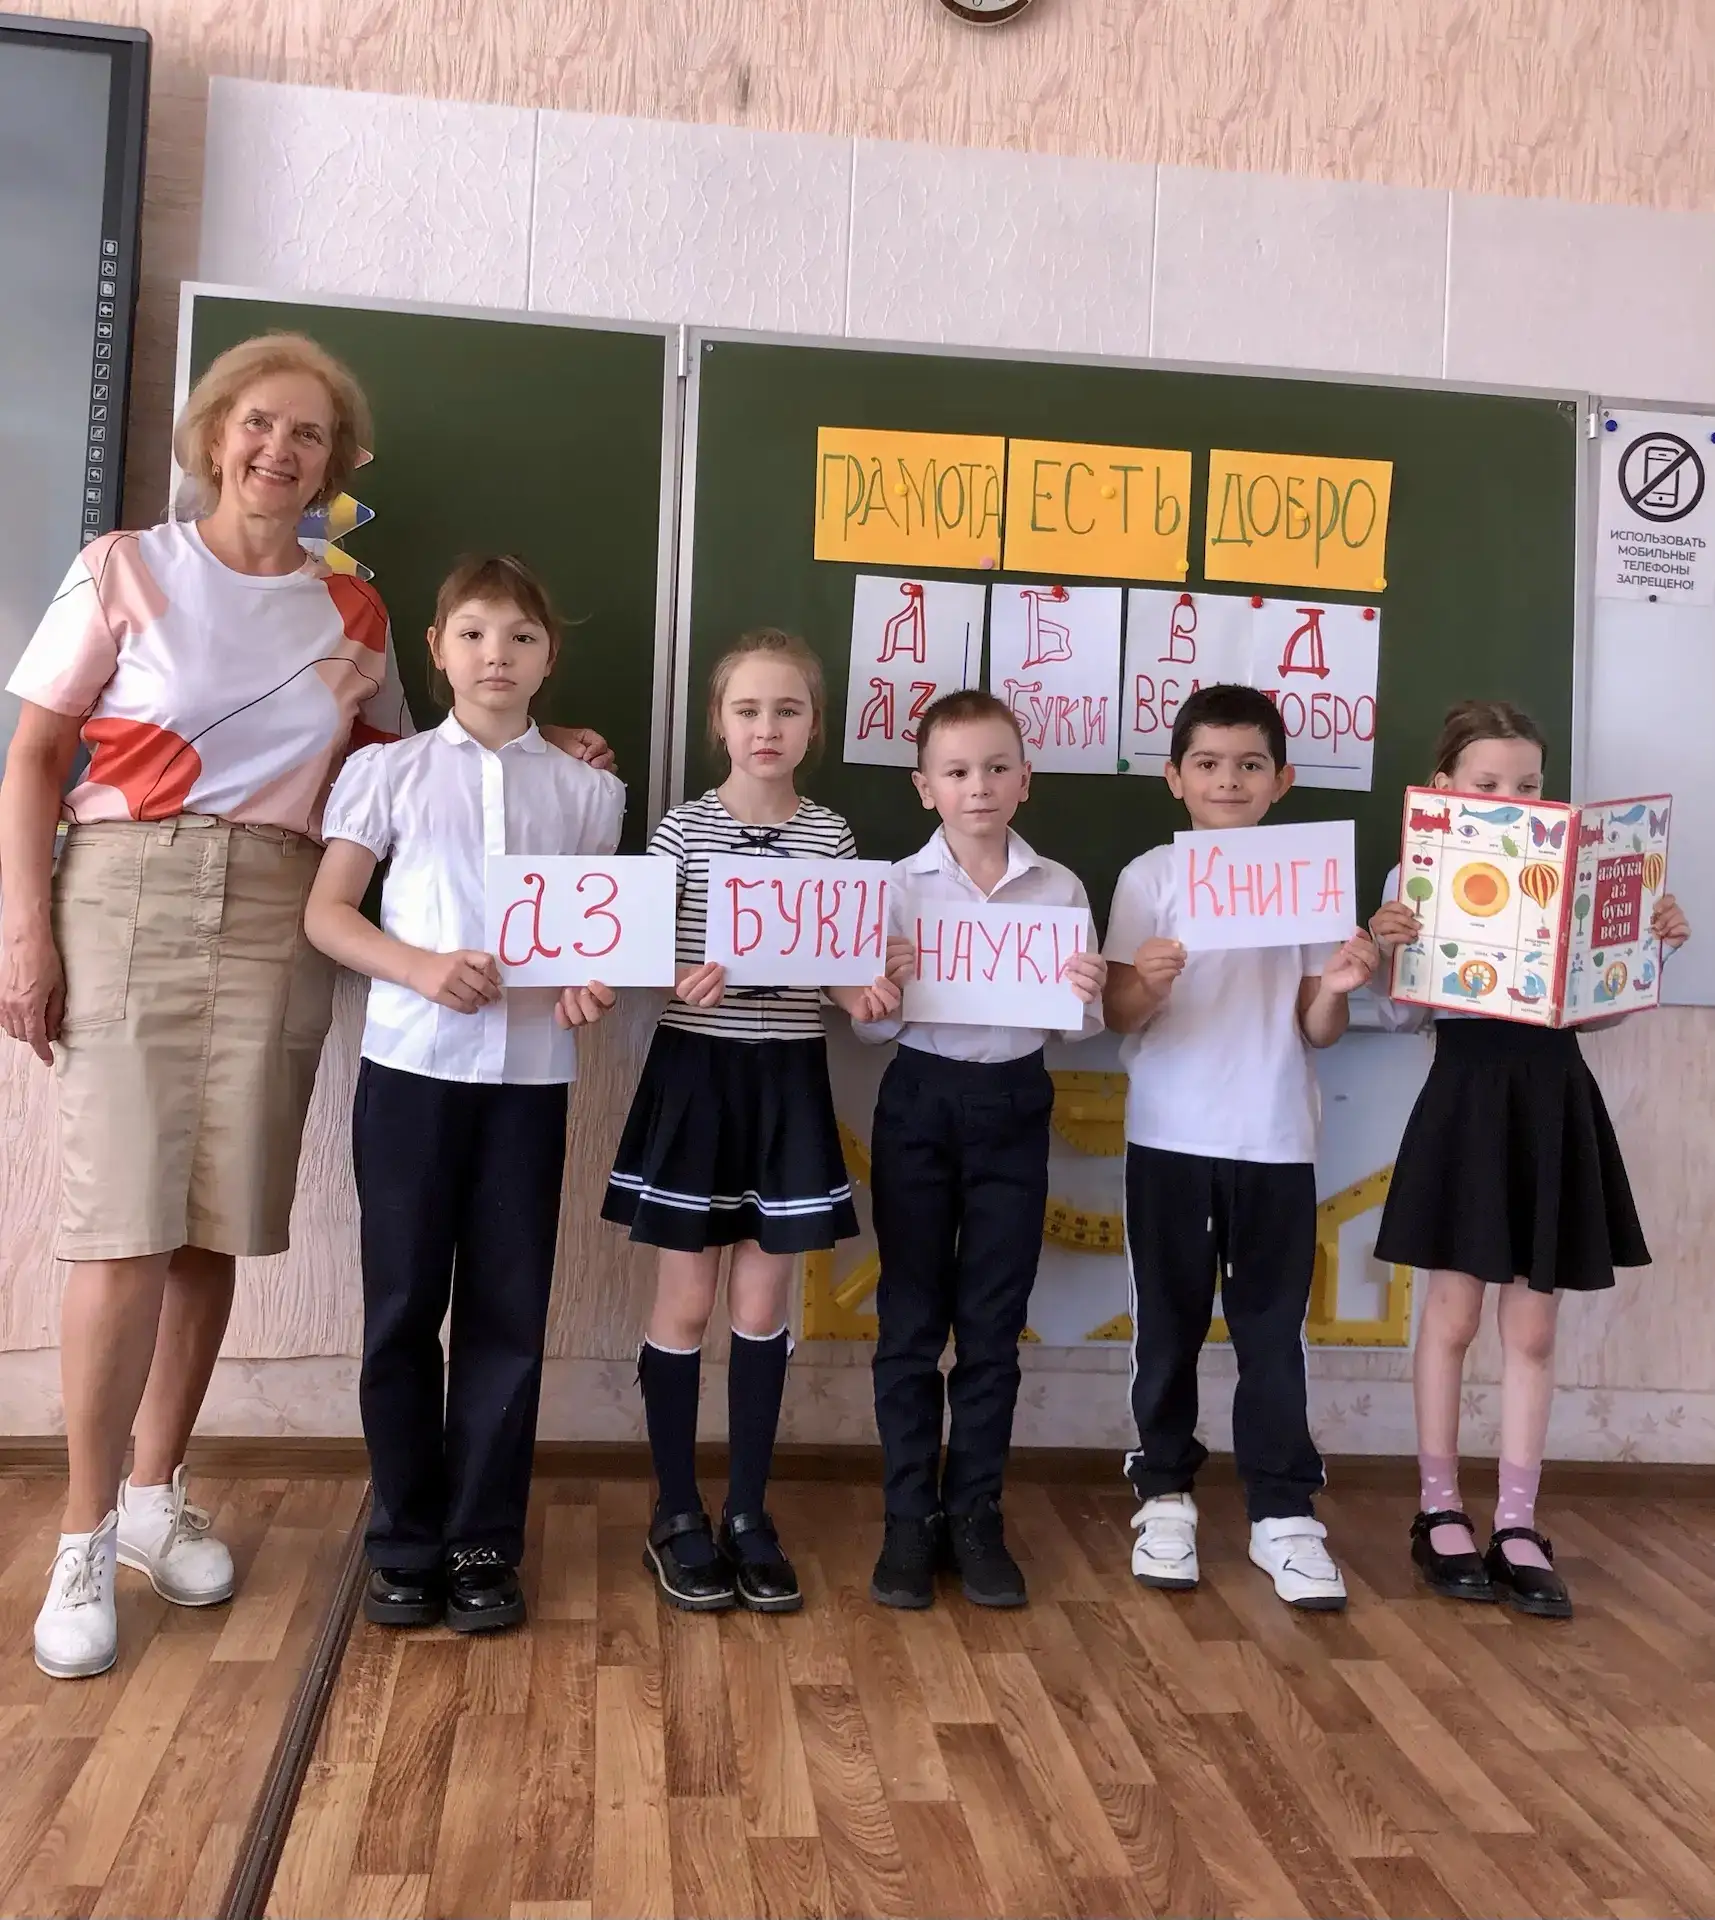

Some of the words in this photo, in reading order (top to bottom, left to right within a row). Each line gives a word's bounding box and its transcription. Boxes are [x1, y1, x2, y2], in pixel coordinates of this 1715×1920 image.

[821, 453, 1002, 542] ГРАМОТА
[1030, 459, 1181, 537] ЕСТЬ
[1210, 472, 1377, 568] ДОБРО
[1610, 530, 1706, 548] ИСПОЛЬЗОВАТЬ
[1617, 545, 1696, 562] МОБИЛЬНЫЕ
[1622, 560, 1690, 575] ТЕЛЕФОНЫ
[1616, 573, 1694, 590] ЗАПРЕЩЕНО!
[876, 582, 926, 664] А
[1019, 589, 1073, 670] Б
[1157, 601, 1198, 664] В
[1277, 608, 1331, 680] Д
[1597, 857, 1643, 883] азбука
[1610, 883, 1627, 899] аз
[724, 877, 888, 959] БУКИ
[1601, 899, 1633, 924] буки
[1599, 921, 1632, 941] веди
